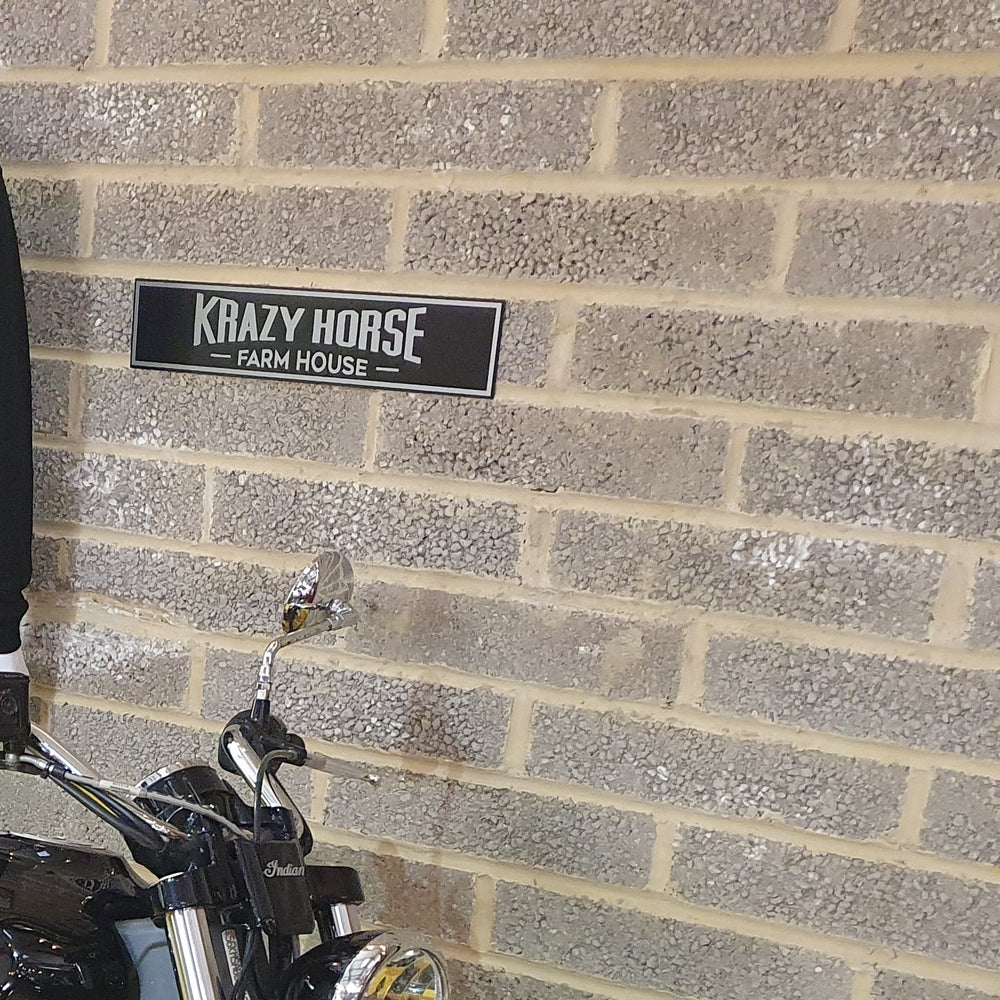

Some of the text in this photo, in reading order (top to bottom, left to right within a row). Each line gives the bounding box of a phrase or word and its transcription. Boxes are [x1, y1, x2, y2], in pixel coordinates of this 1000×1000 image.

[193, 292, 428, 365] KRAZY HORSE
[236, 348, 368, 377] FARM HOUSE
[263, 859, 305, 878] Indian
